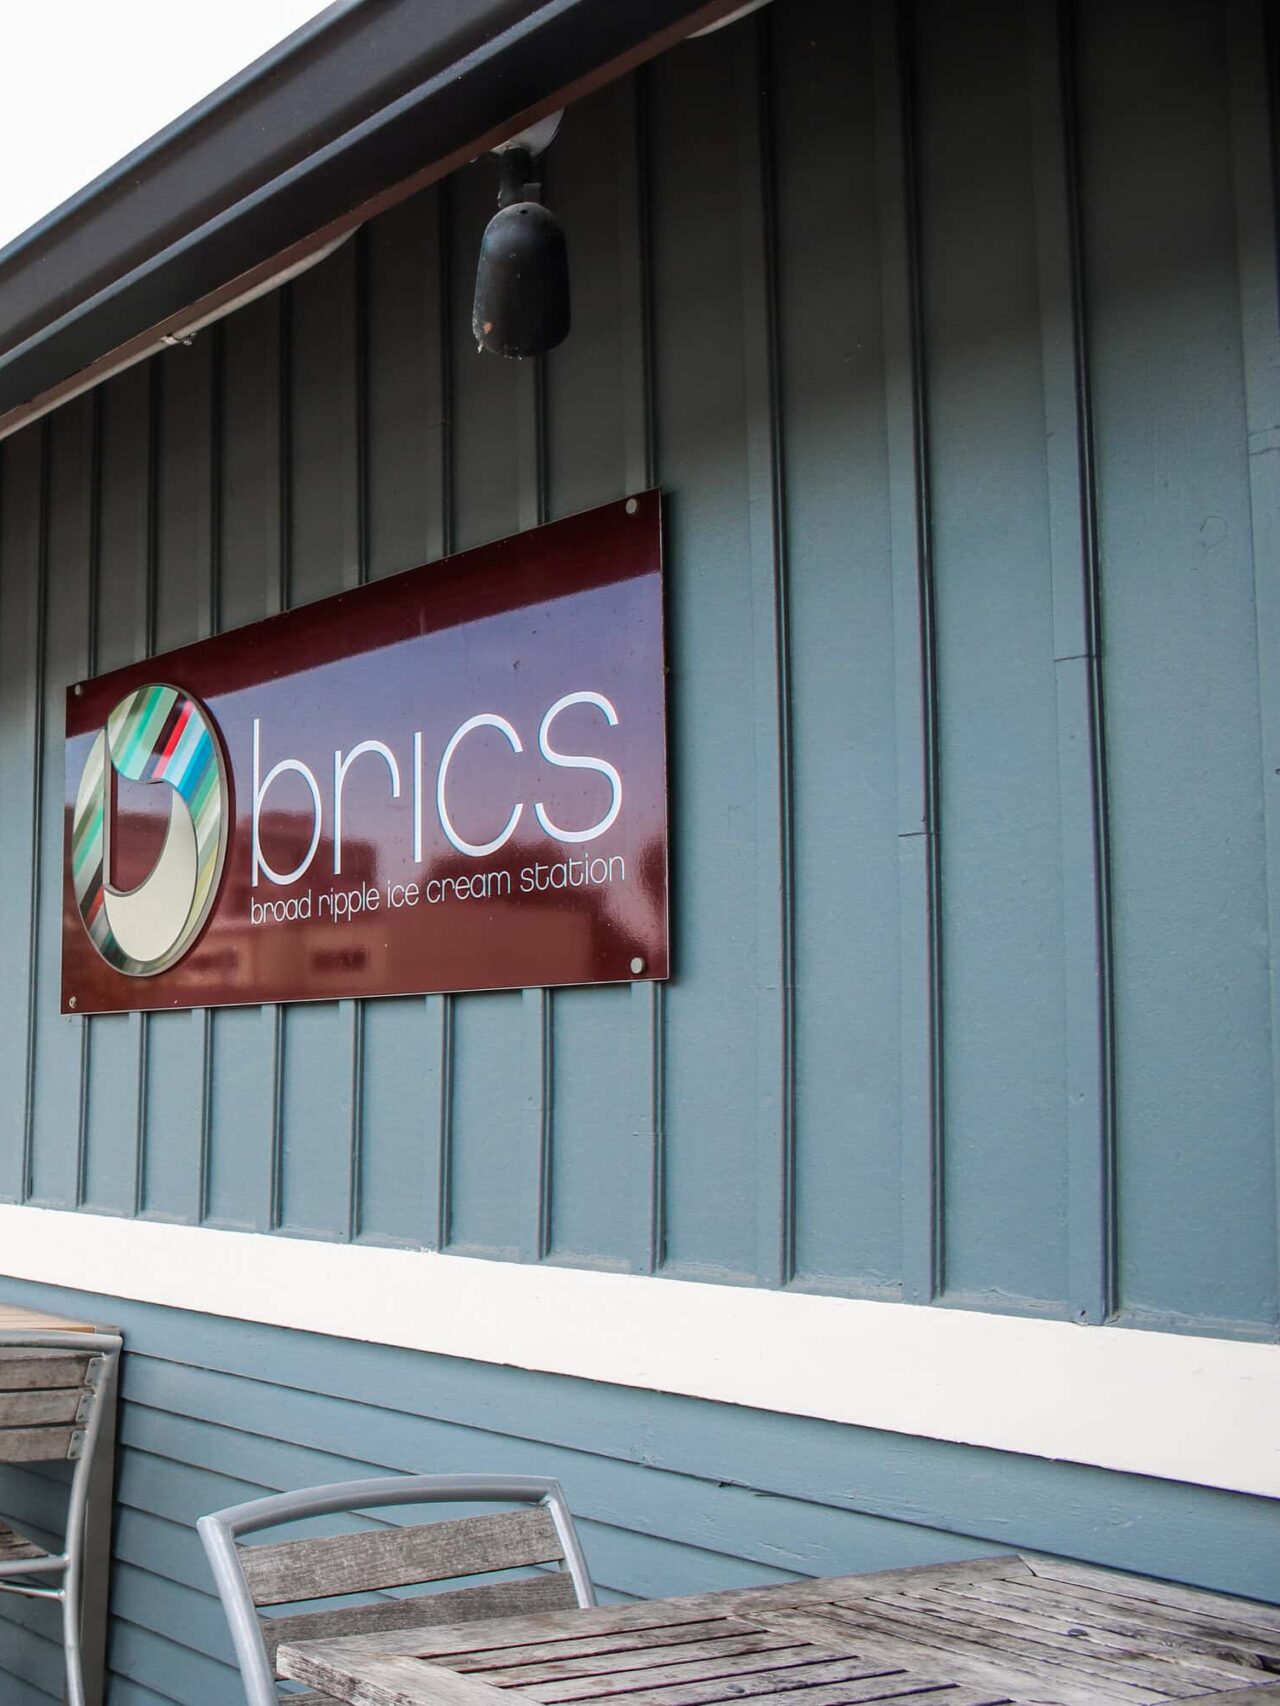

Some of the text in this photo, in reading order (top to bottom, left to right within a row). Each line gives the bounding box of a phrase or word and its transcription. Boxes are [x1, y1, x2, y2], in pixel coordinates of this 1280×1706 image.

[251, 853, 625, 925] broad ripple ice cream station
